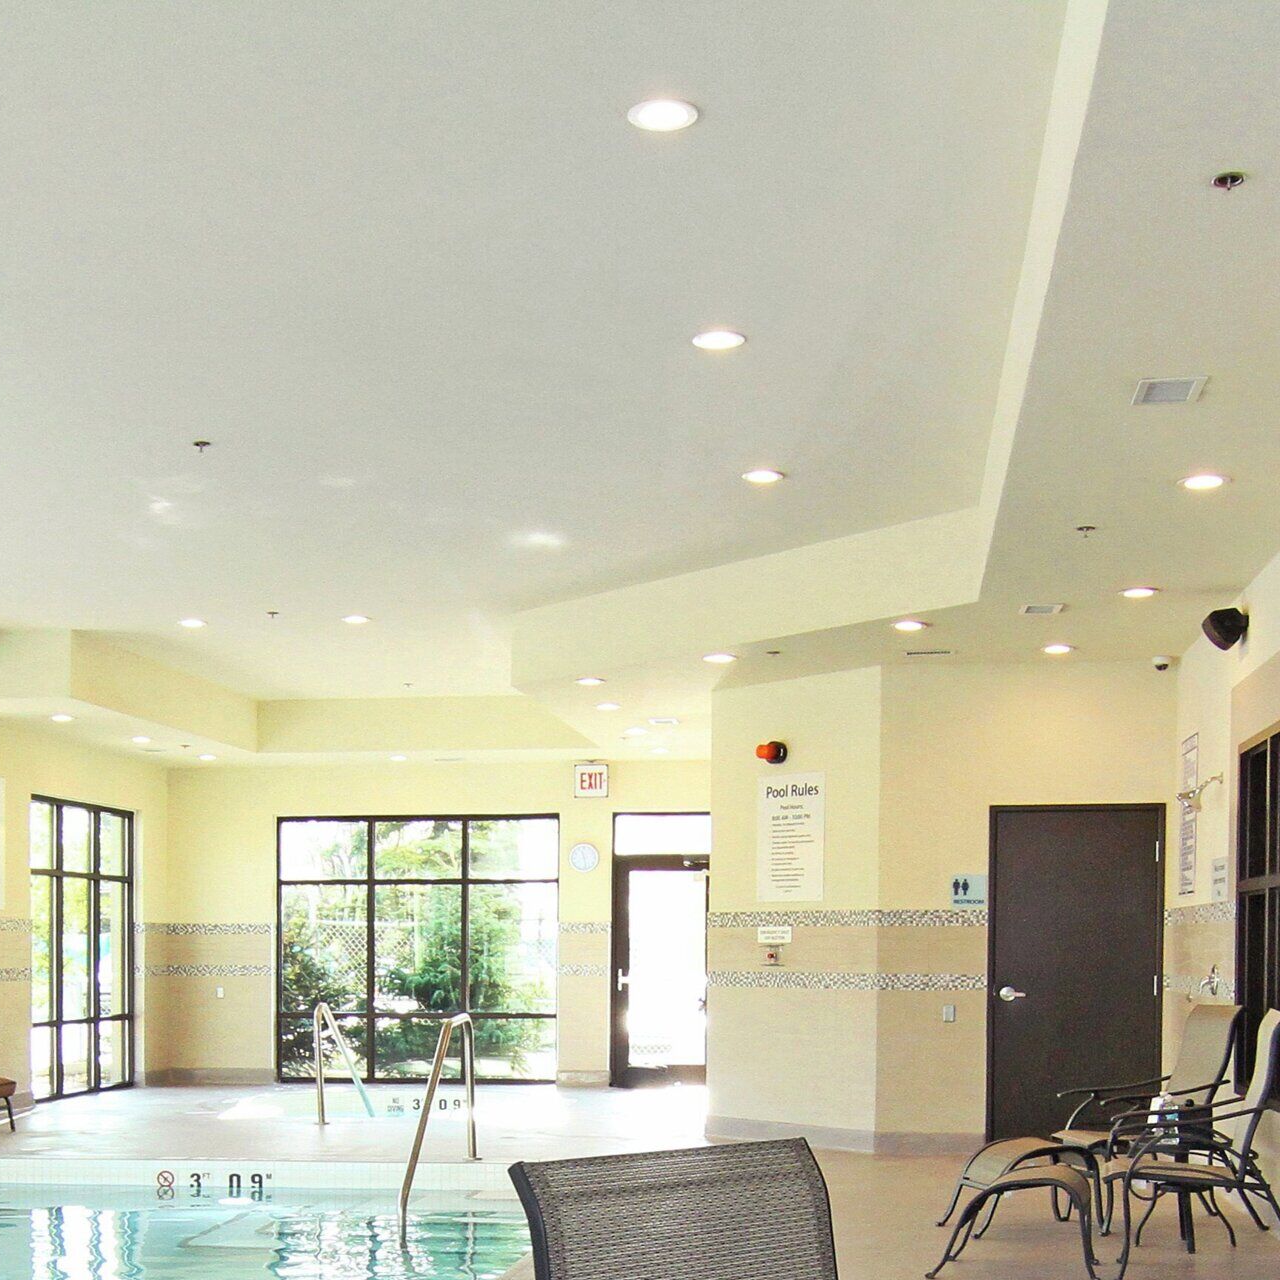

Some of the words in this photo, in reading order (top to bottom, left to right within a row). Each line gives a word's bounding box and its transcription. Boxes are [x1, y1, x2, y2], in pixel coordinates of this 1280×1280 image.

[580, 772, 604, 790] EXIT
[766, 785, 789, 799] Pool
[790, 782, 819, 797] Rules
[412, 1099, 420, 1110] 3
[190, 1173, 201, 1189] 3
